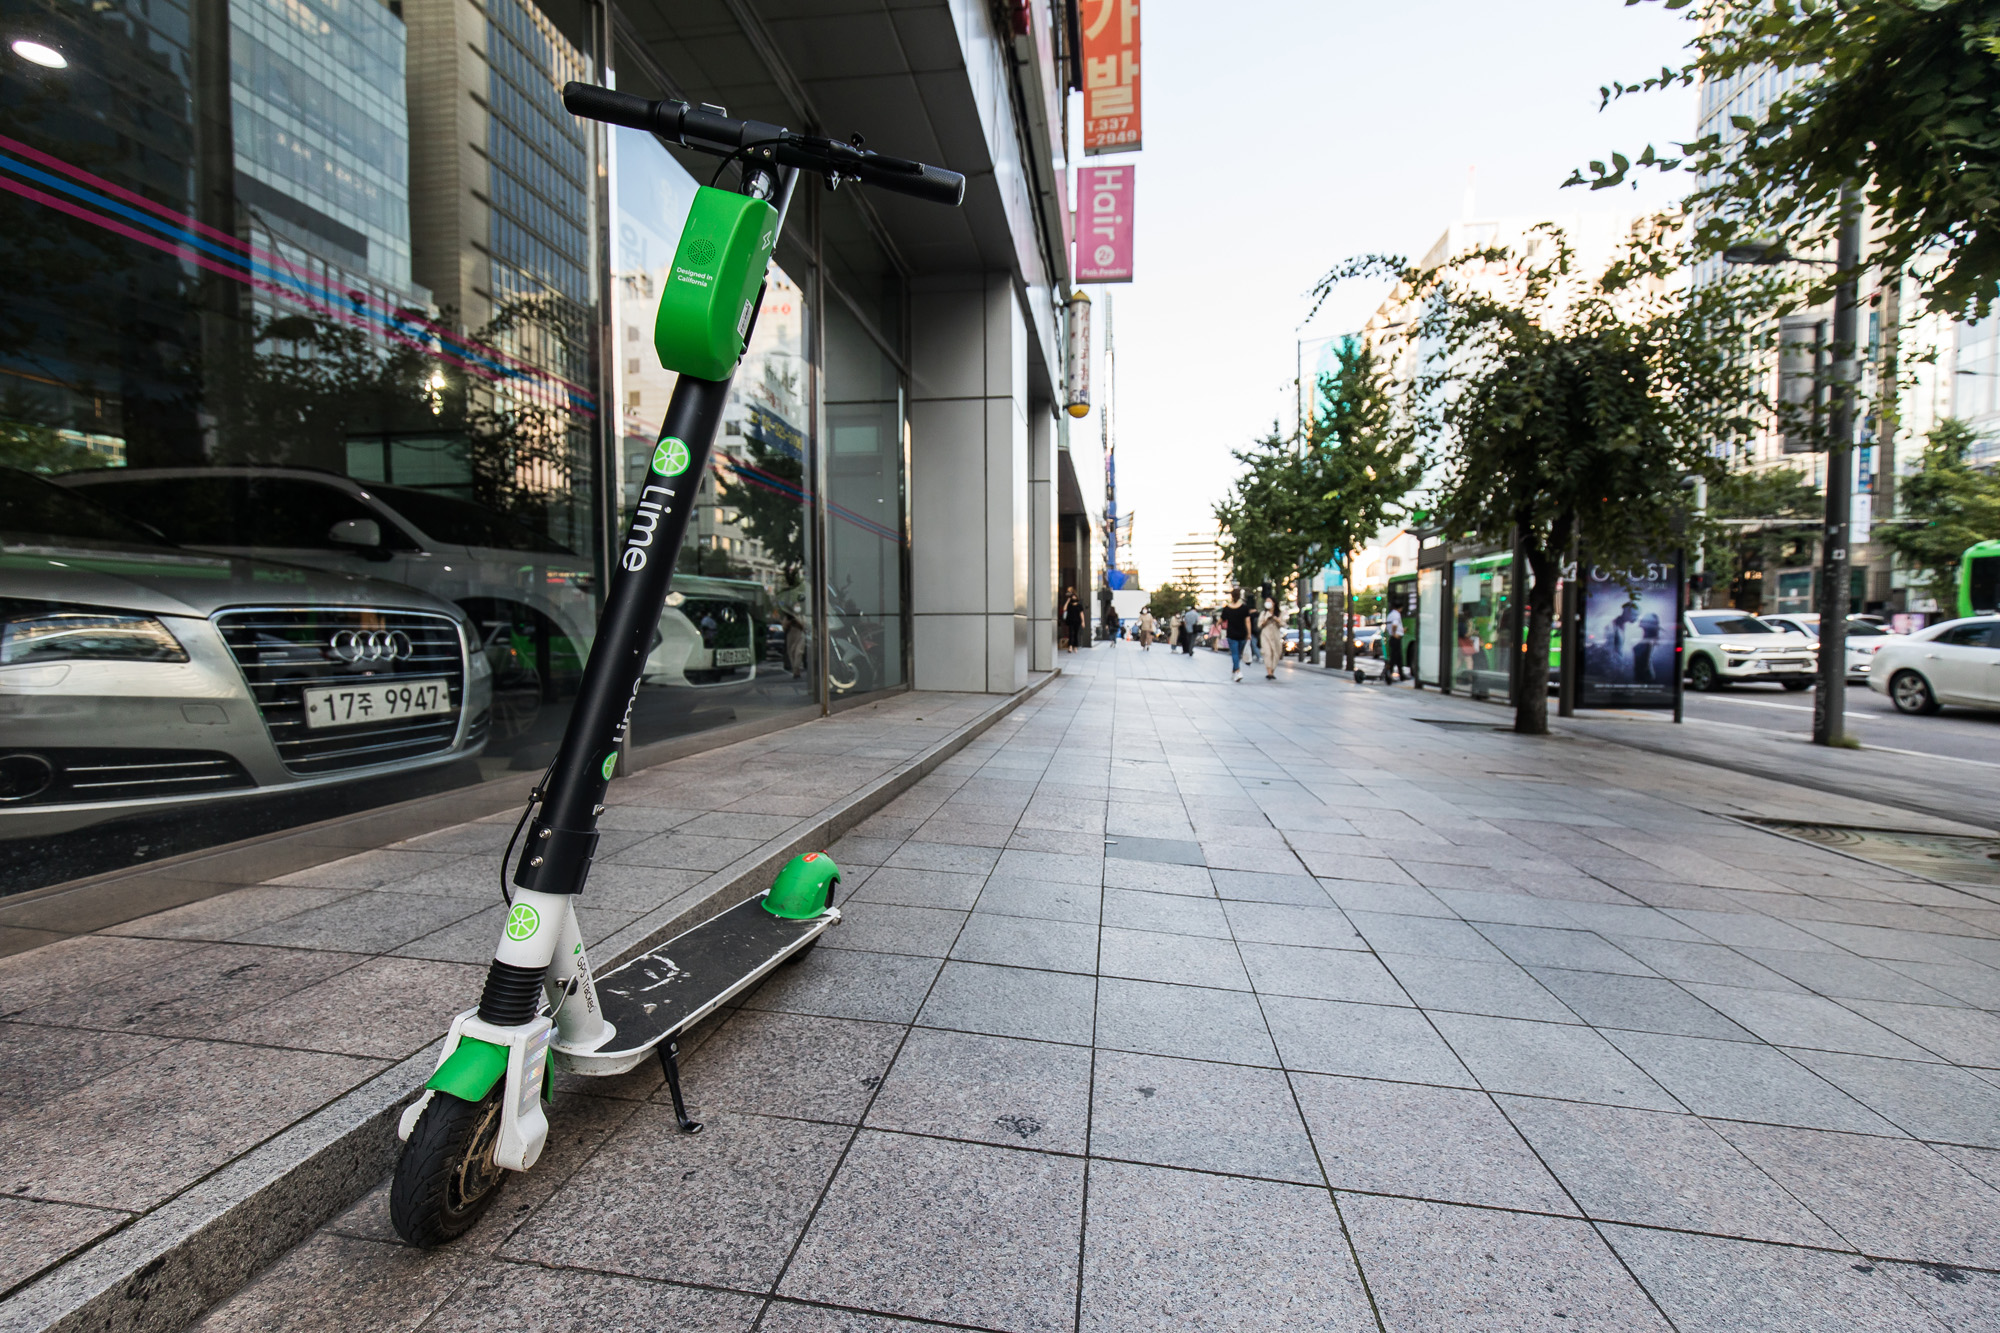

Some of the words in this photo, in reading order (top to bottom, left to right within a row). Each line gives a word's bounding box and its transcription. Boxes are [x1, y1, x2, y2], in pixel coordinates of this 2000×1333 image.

[1085, 0, 1139, 118] 가발
[1093, 169, 1123, 241] Hair
[676, 266, 706, 281] Designed
[706, 273, 713, 281] in
[677, 274, 708, 288] California
[622, 485, 676, 572] Lime
[323, 692, 373, 721] 17주
[384, 685, 438, 714] 9947
[576, 956, 588, 978] GPS
